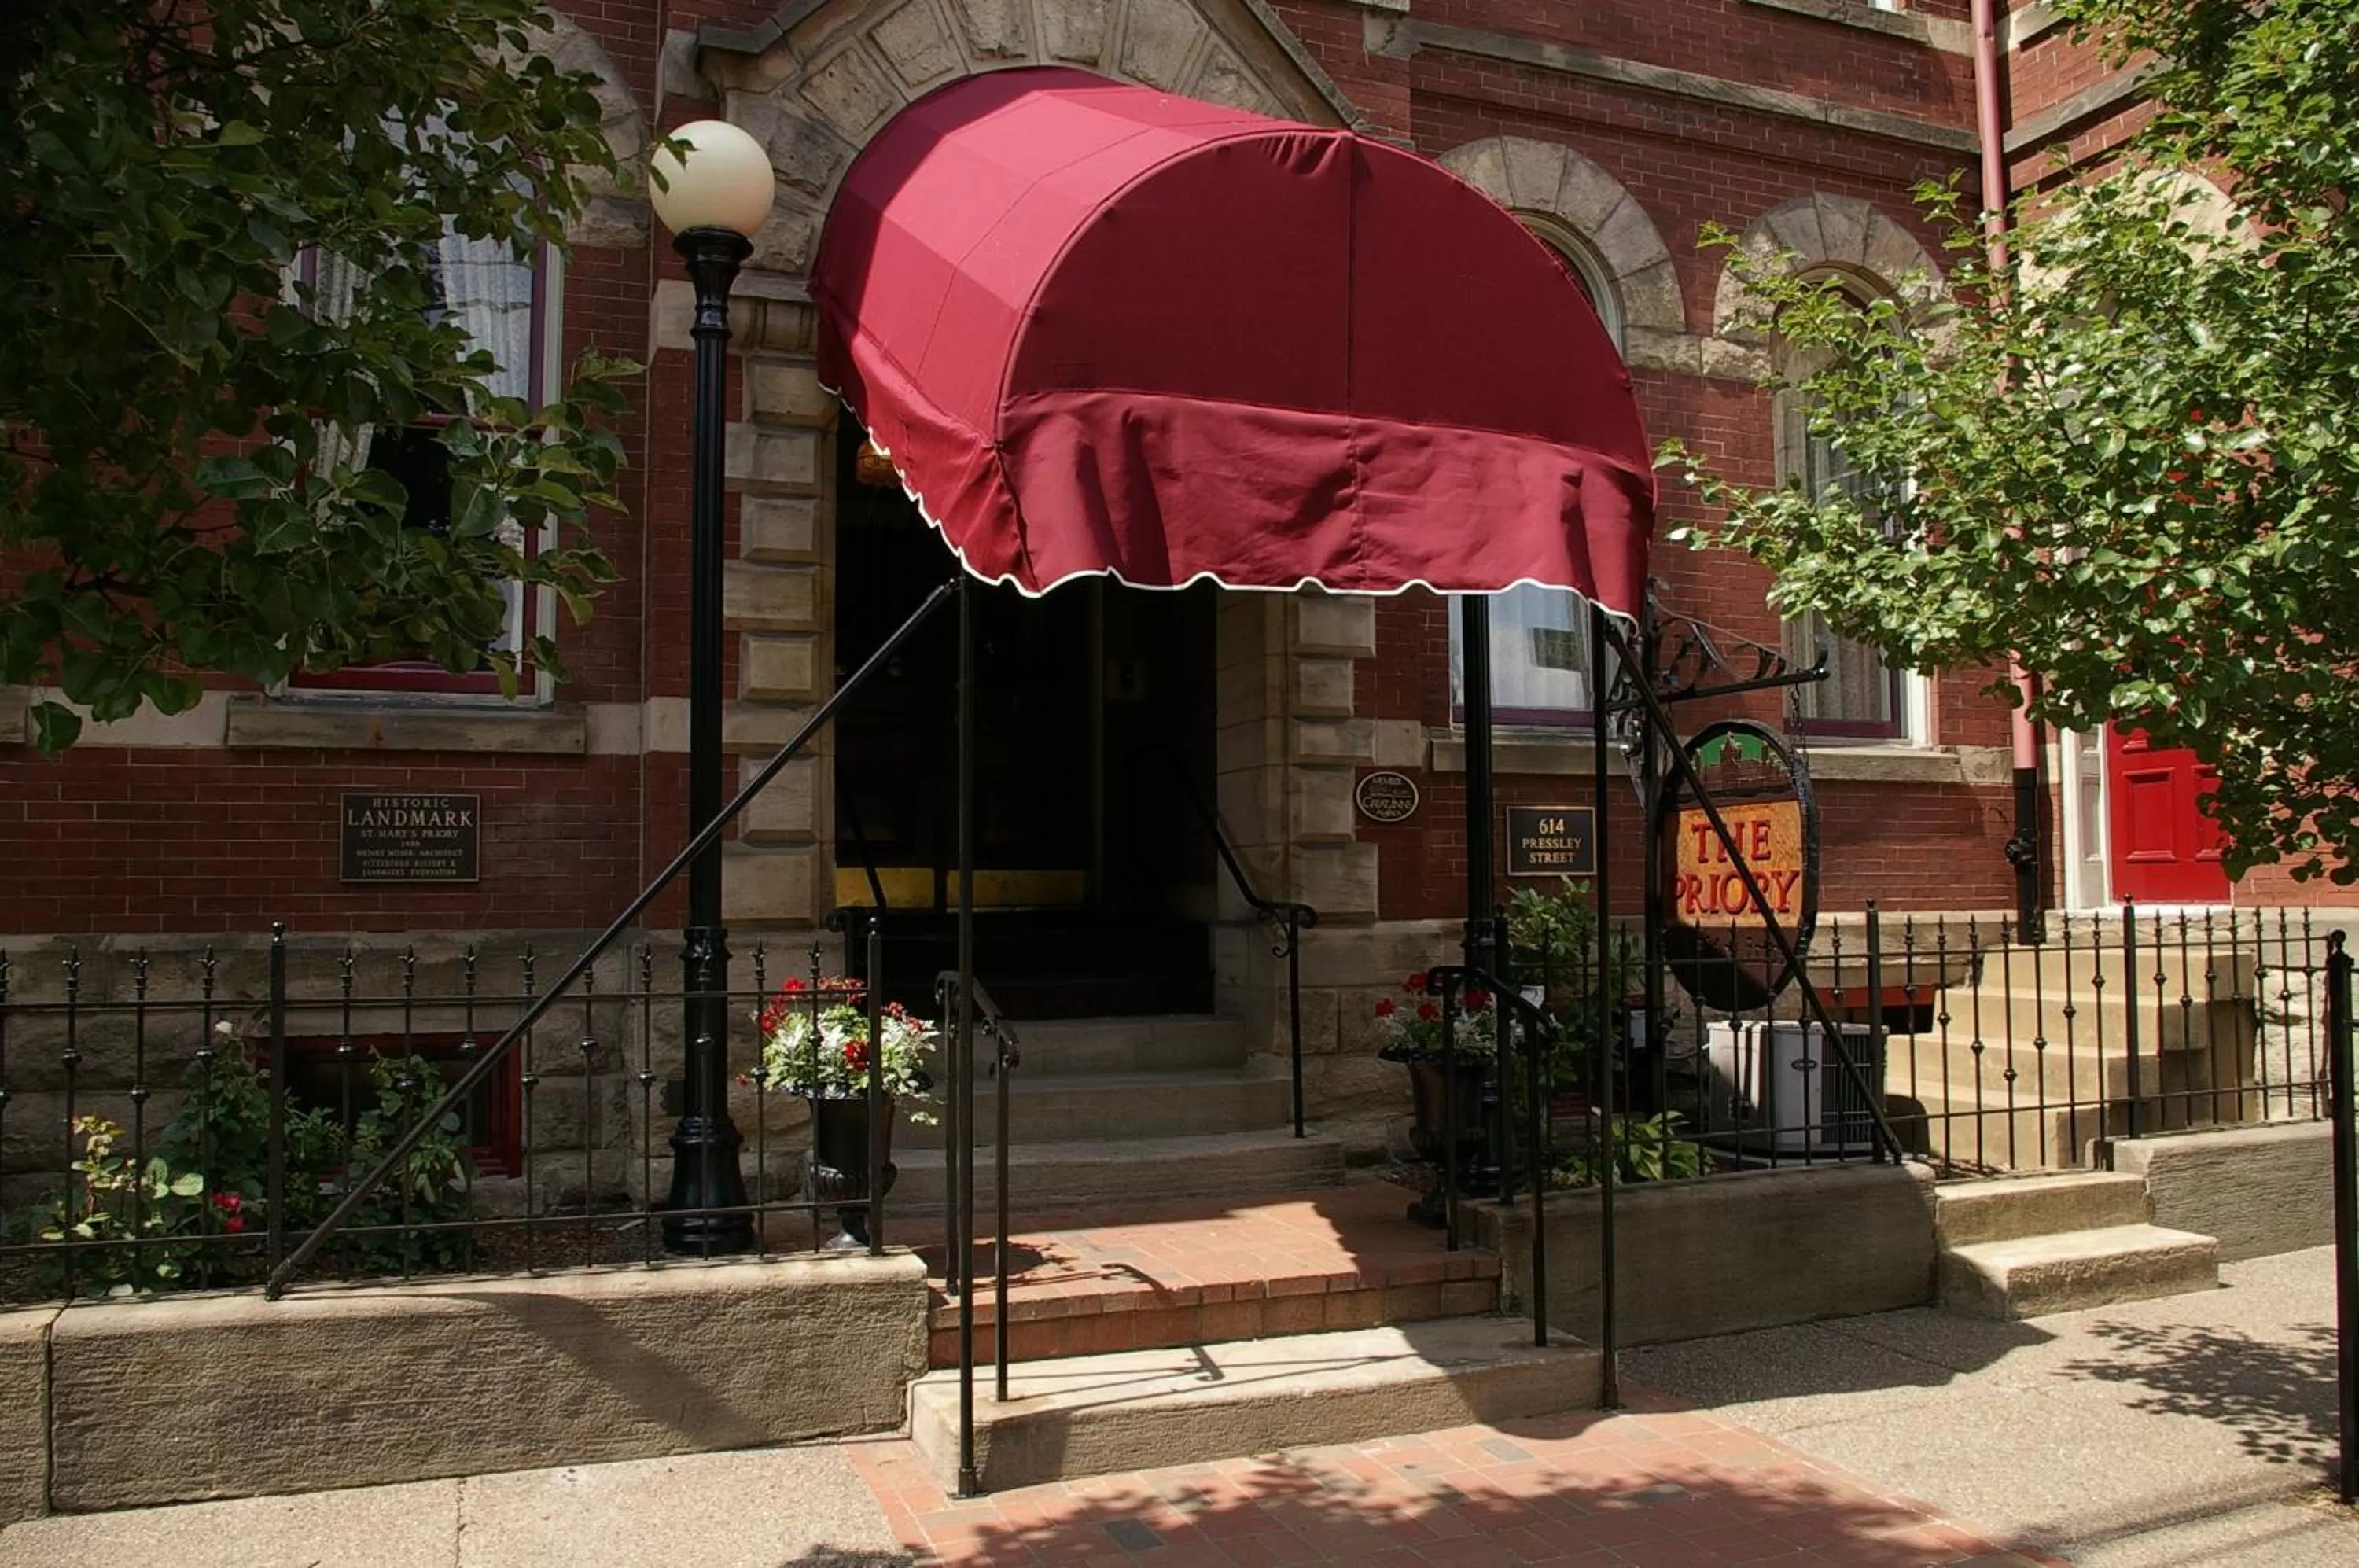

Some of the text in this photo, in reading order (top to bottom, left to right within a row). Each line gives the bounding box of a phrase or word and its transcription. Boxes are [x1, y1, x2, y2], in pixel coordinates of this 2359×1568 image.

[372, 797, 451, 808] HISTORIC
[348, 809, 473, 826] LANDMARK
[1539, 818, 1566, 834] 614
[422, 830, 460, 838] PRIORY
[1522, 837, 1582, 848] PRESSLEY
[1691, 819, 1772, 863] THE
[1529, 852, 1575, 863] STREET
